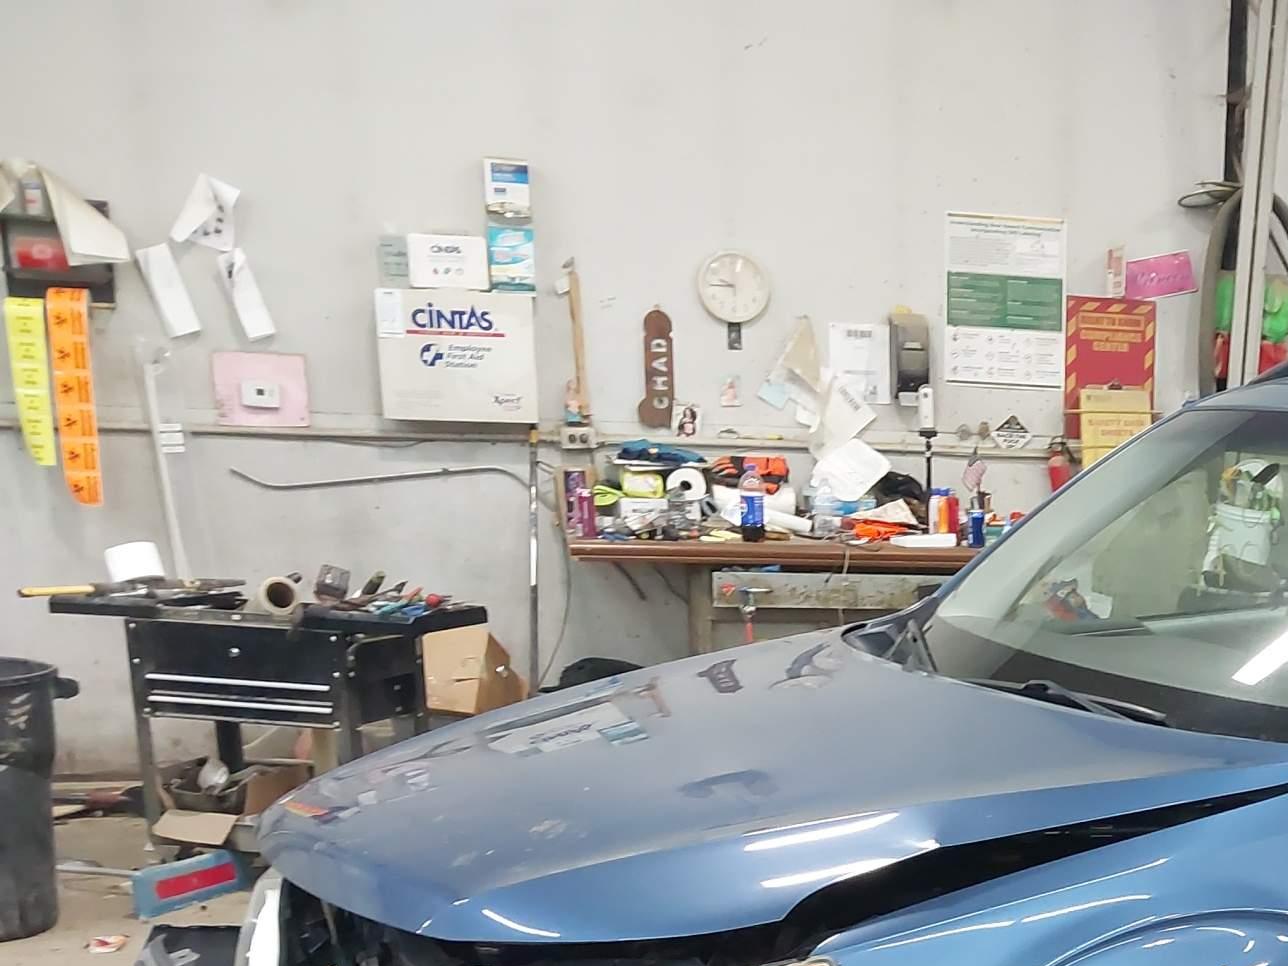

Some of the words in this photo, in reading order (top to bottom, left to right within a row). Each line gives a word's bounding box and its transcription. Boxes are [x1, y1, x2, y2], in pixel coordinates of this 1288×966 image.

[411, 302, 493, 331] CINTAS
[448, 343, 492, 354] Employee
[650, 338, 669, 409] CHAD
